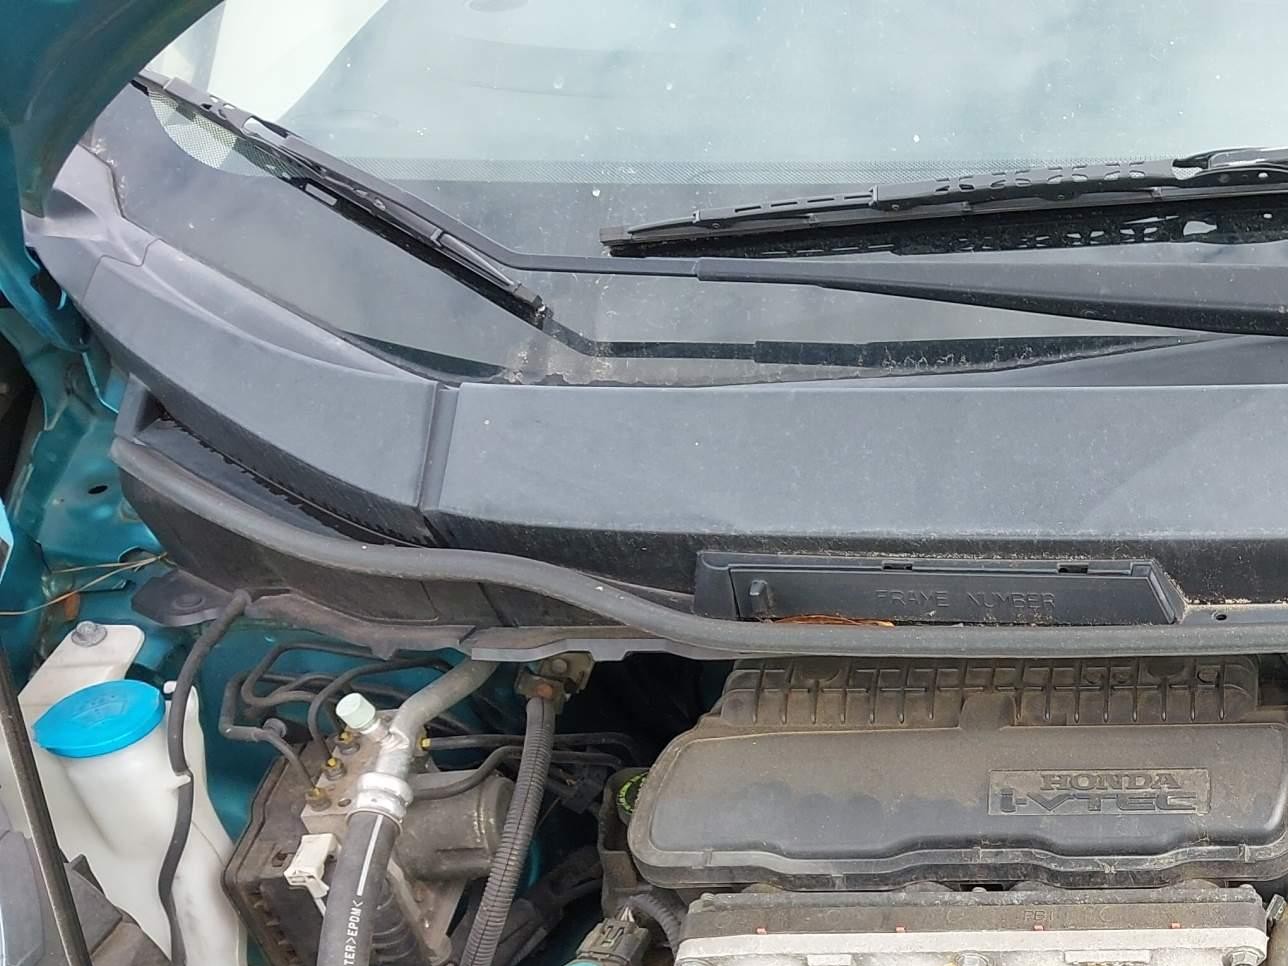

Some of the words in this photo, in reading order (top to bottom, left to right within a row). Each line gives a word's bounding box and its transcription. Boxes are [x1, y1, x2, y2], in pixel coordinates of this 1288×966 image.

[875, 588, 950, 607] FRAME
[966, 590, 1056, 608] NUMBER
[1039, 773, 1182, 791] HONDA
